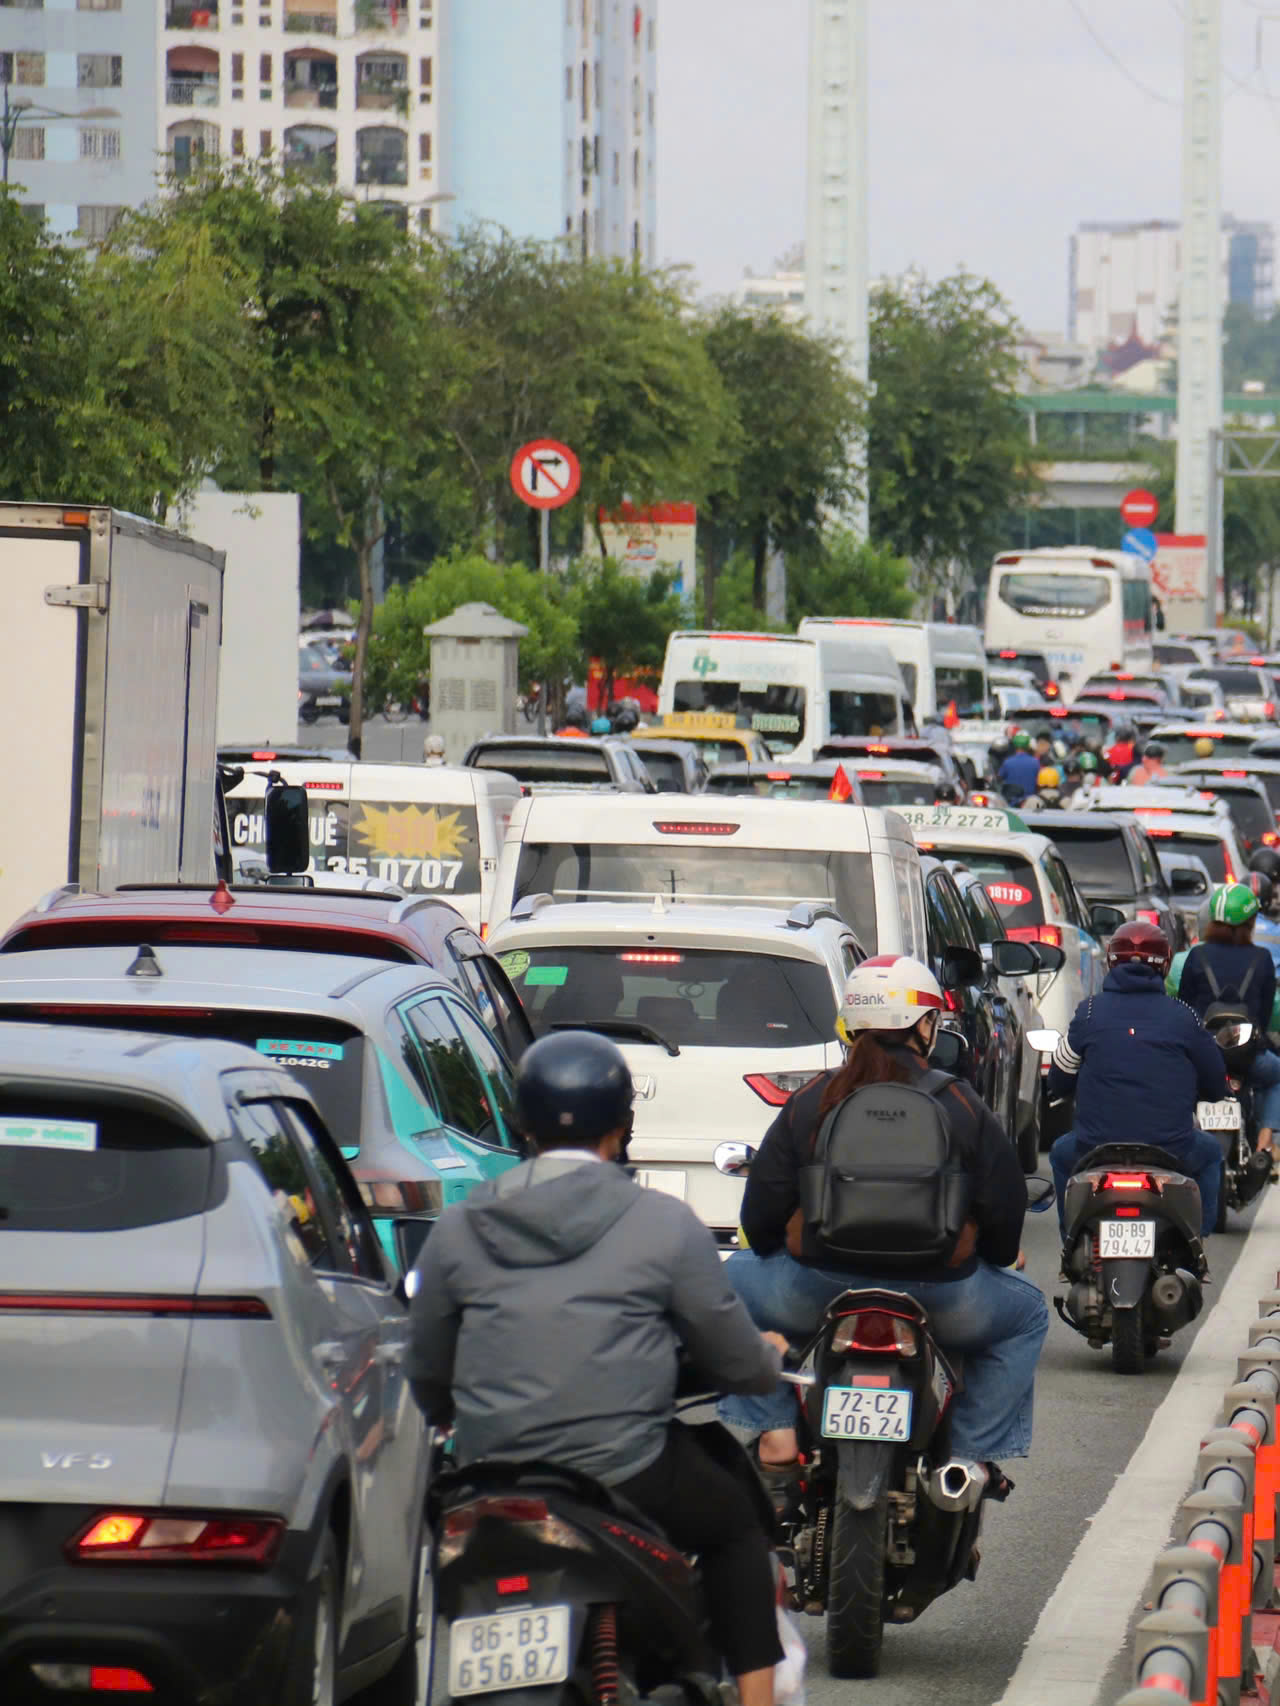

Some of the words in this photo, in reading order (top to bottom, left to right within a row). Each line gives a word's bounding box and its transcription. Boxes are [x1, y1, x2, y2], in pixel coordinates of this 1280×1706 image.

[234, 813, 267, 846] CH
[957, 815, 977, 827] 27
[983, 816, 1004, 828] 27
[296, 1043, 333, 1056] TAXI
[1108, 1223, 1146, 1238] 60-B9
[1103, 1239, 1151, 1255] 794.47
[840, 1391, 899, 1415] 72-C2
[830, 1413, 905, 1437] 506.24
[471, 1615, 549, 1654] 86-B3
[459, 1646, 559, 1689] 656.87
